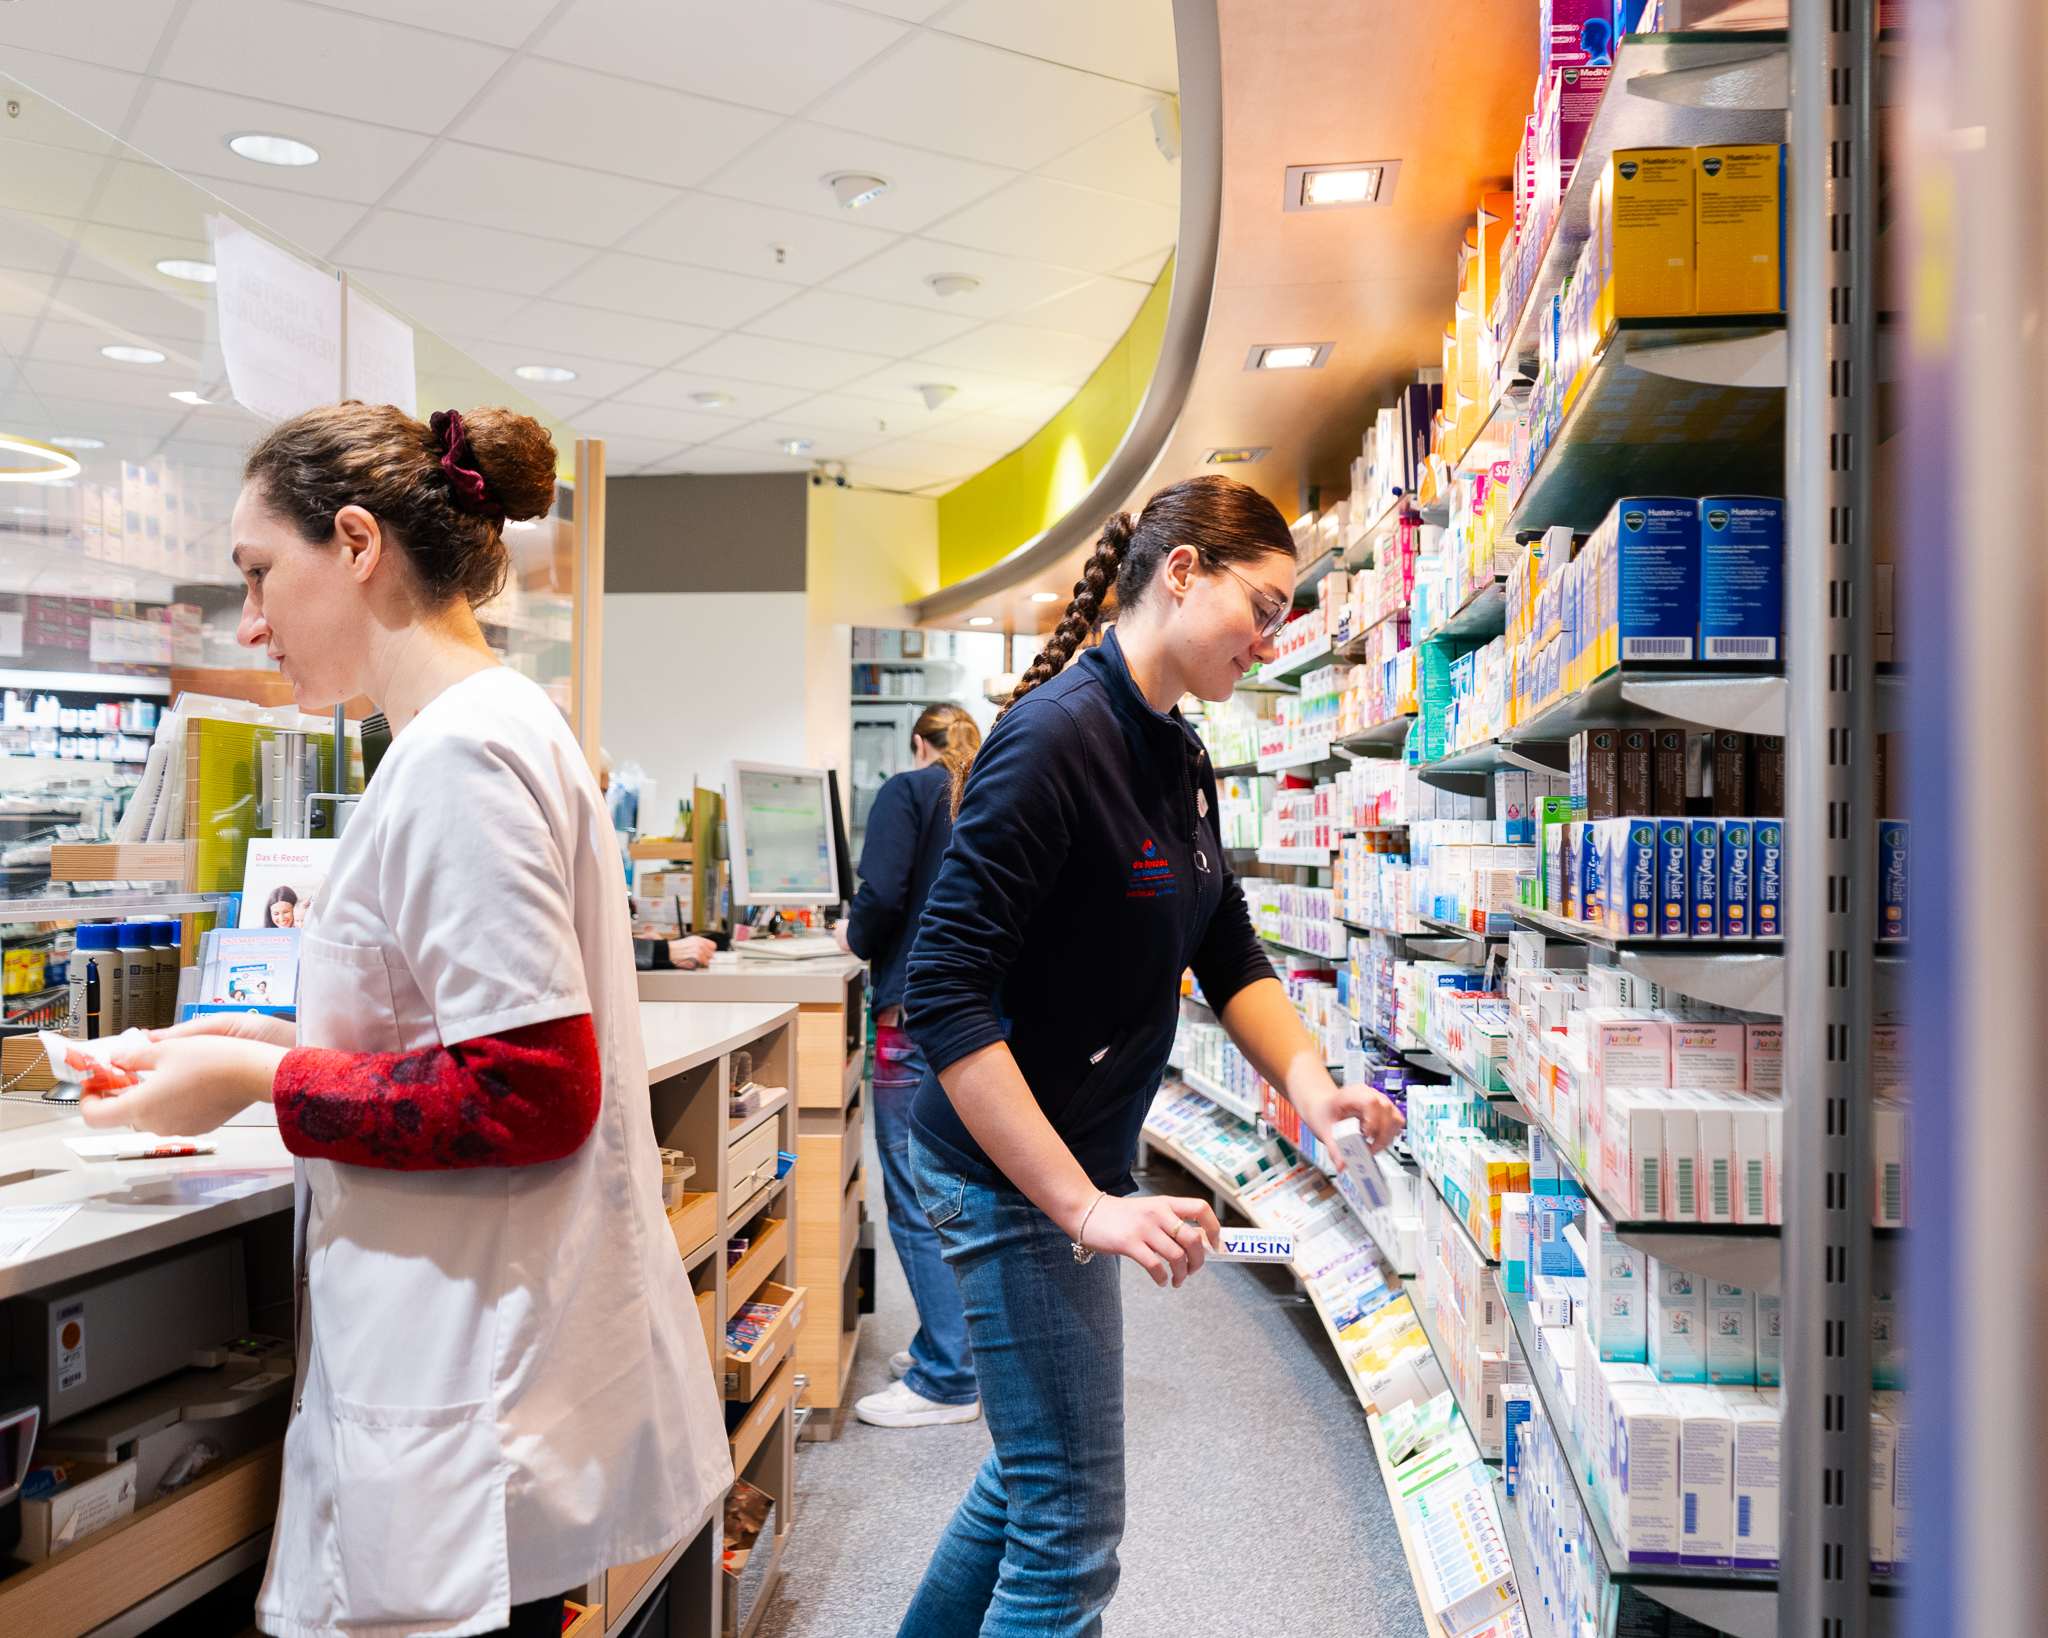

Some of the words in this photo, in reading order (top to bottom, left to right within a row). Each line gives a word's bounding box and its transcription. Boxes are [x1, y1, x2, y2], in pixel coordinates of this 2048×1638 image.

[1648, 508, 1693, 517] Husten-Sirup
[1731, 508, 1776, 516] Husten-Sirup
[1606, 752, 1614, 774] Sulagil
[1639, 752, 1648, 775] Sulagil
[1606, 775, 1614, 806] Halsspray
[1639, 775, 1647, 806] Halsspray
[256, 854, 270, 862] Das
[273, 854, 309, 863] E-Rezept
[1636, 849, 1653, 899] DayNait
[1667, 848, 1683, 899] DayNait
[1699, 848, 1715, 900] DayNait
[1731, 849, 1747, 900] DayNait
[1763, 849, 1779, 900] DayNait
[1888, 850, 1906, 902] DayNait
[1606, 1034, 1644, 1045] junior
[1679, 1036, 1717, 1048] junior
[1224, 1242, 1290, 1254] NISITA
[1233, 1234, 1291, 1242] NASENSALBE
